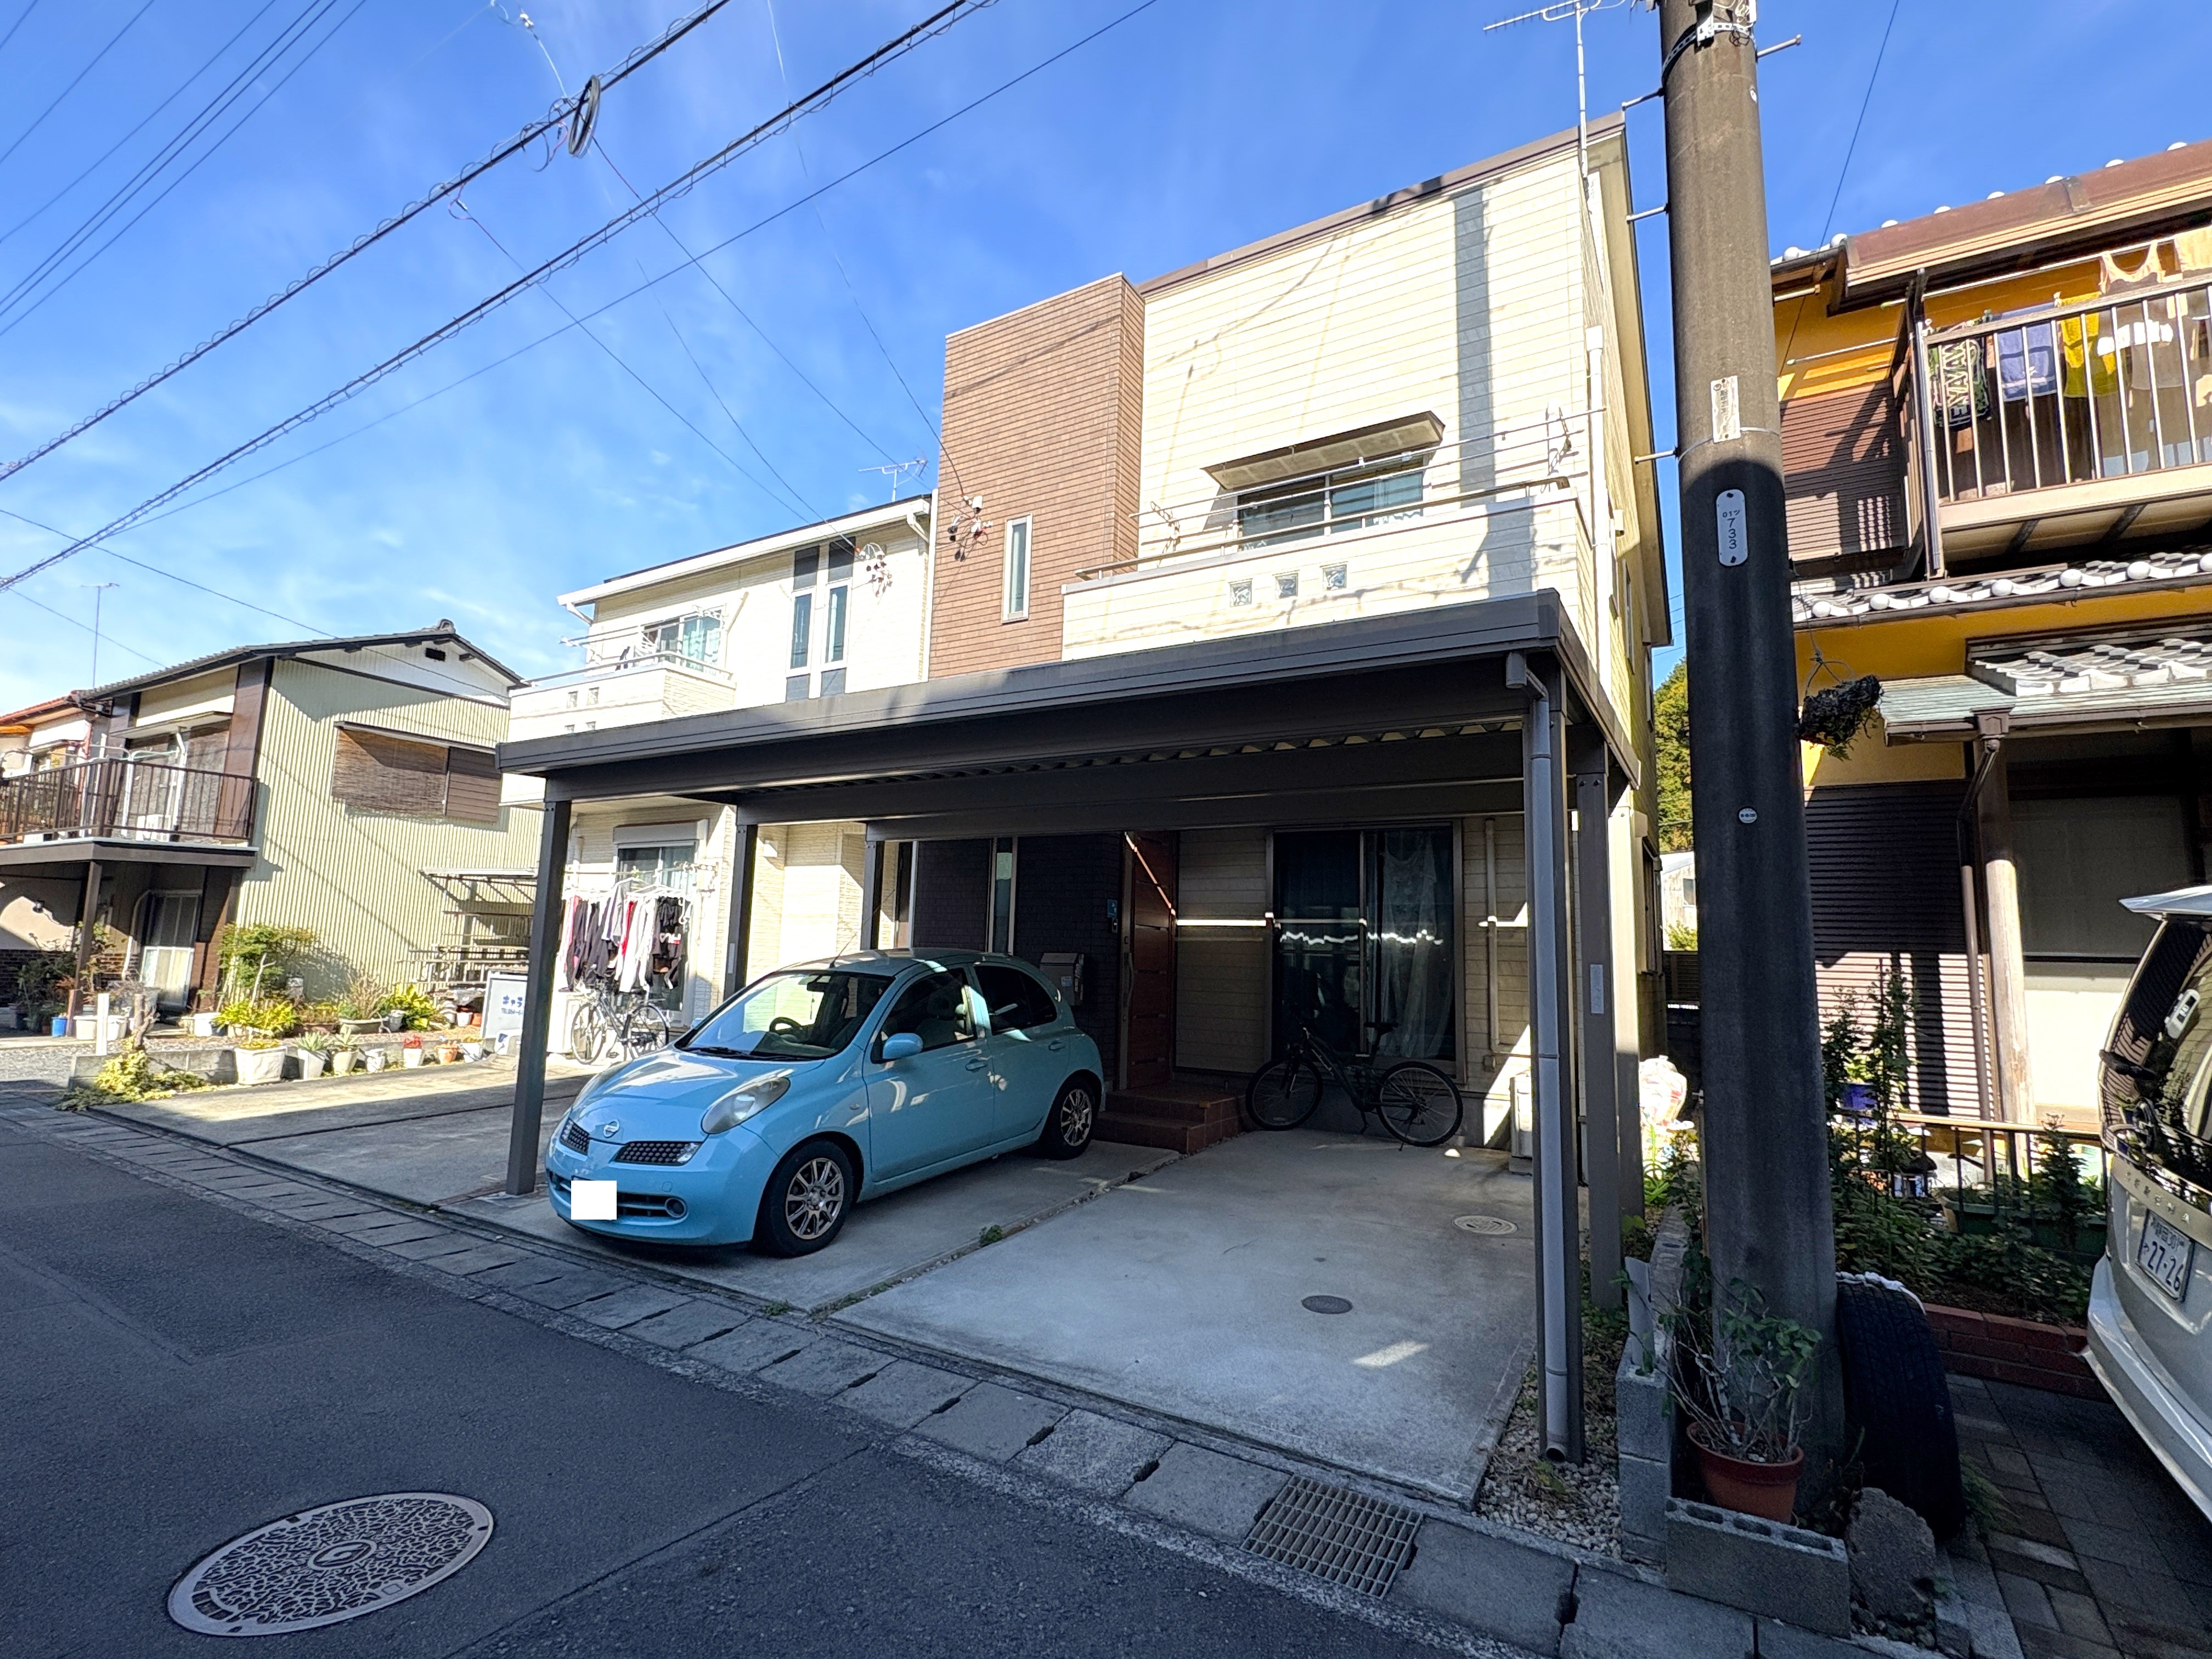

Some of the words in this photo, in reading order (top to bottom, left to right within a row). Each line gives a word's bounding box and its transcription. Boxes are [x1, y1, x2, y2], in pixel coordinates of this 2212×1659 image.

[1726, 517, 1737, 550] 733
[659, 933, 681, 945] FILA
[2125, 1171, 2190, 1224] SERENA
